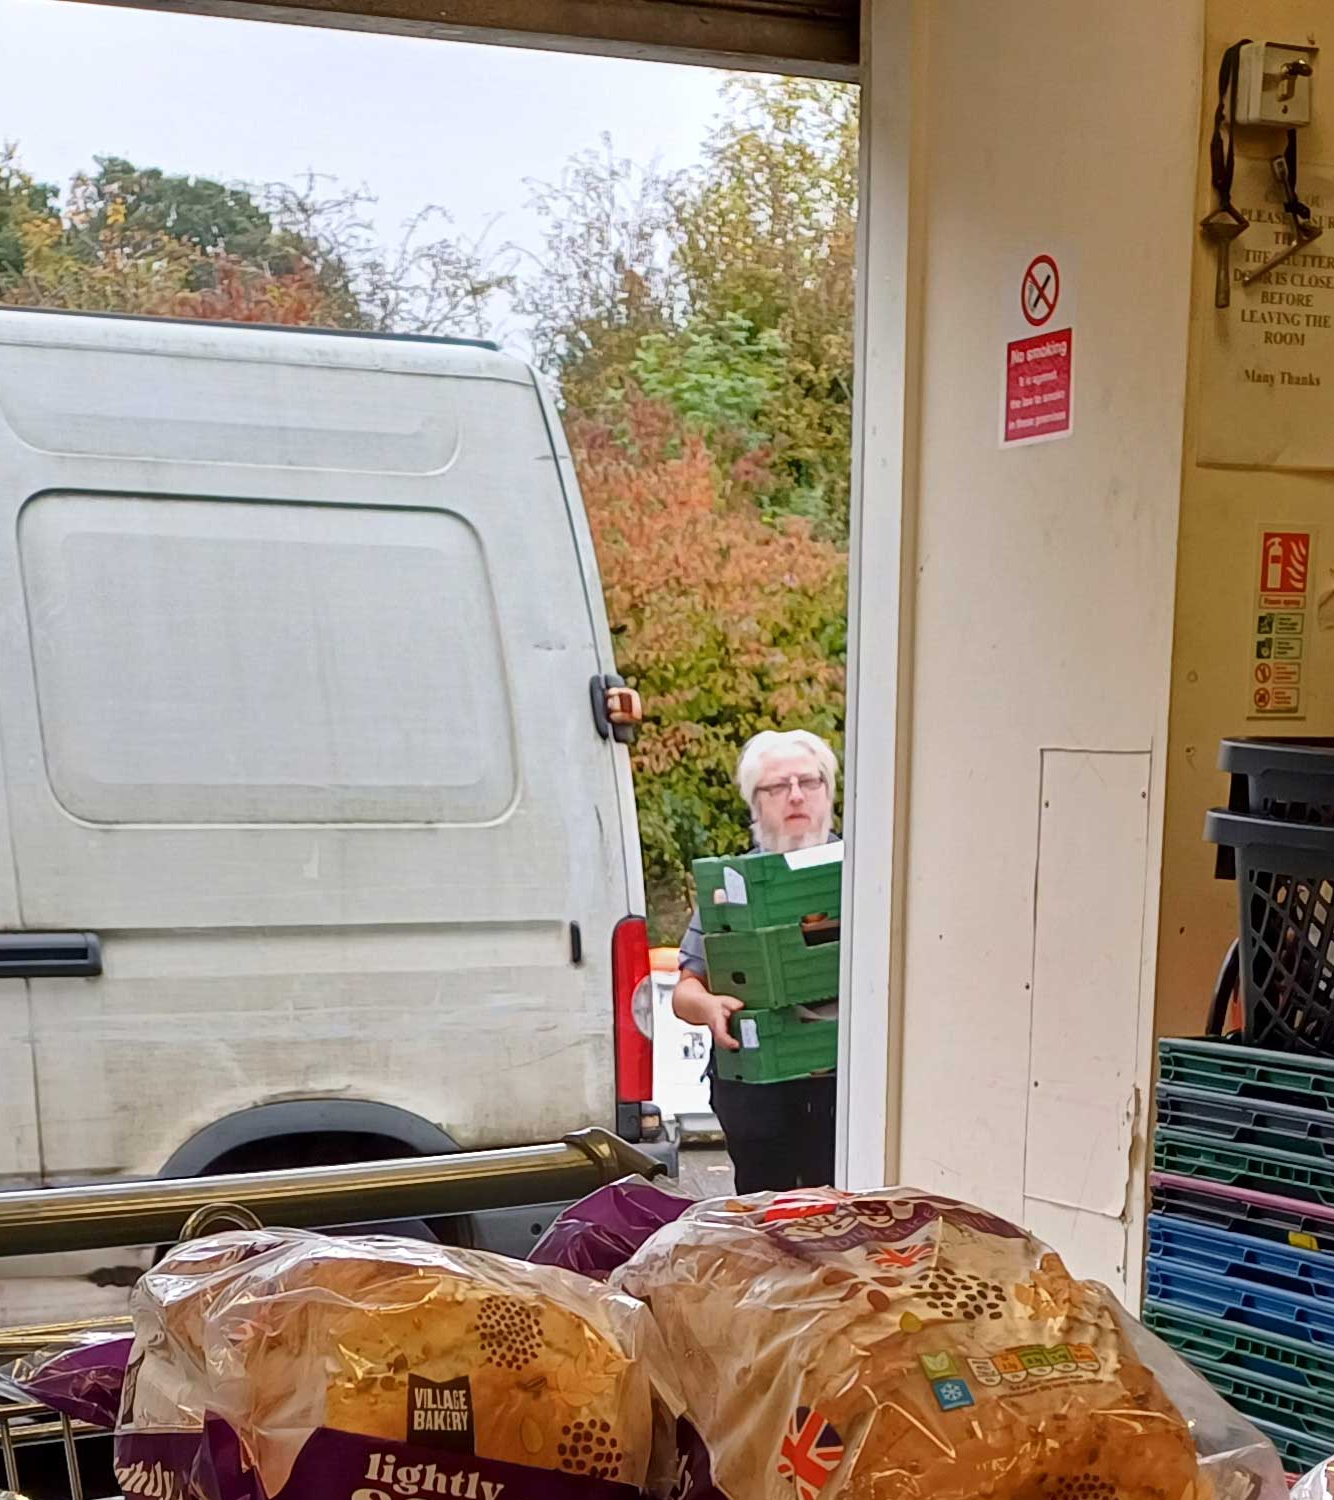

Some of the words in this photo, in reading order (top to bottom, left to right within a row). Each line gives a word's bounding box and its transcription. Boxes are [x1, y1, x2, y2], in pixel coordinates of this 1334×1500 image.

[1233, 269, 1273, 285] DR
[1275, 272, 1288, 286] IS
[1260, 290, 1315, 308] BEFORE
[1240, 308, 1301, 327] LEAVING
[1304, 313, 1332, 329] THE
[1263, 330, 1306, 347] ROOM
[1010, 348, 1025, 365] No
[1026, 341, 1068, 362] smoking
[1244, 368, 1275, 388] Many
[1280, 370, 1322, 387] Thanks
[414, 1387, 468, 1411] VILLAGE
[413, 1409, 468, 1432] BAKERY
